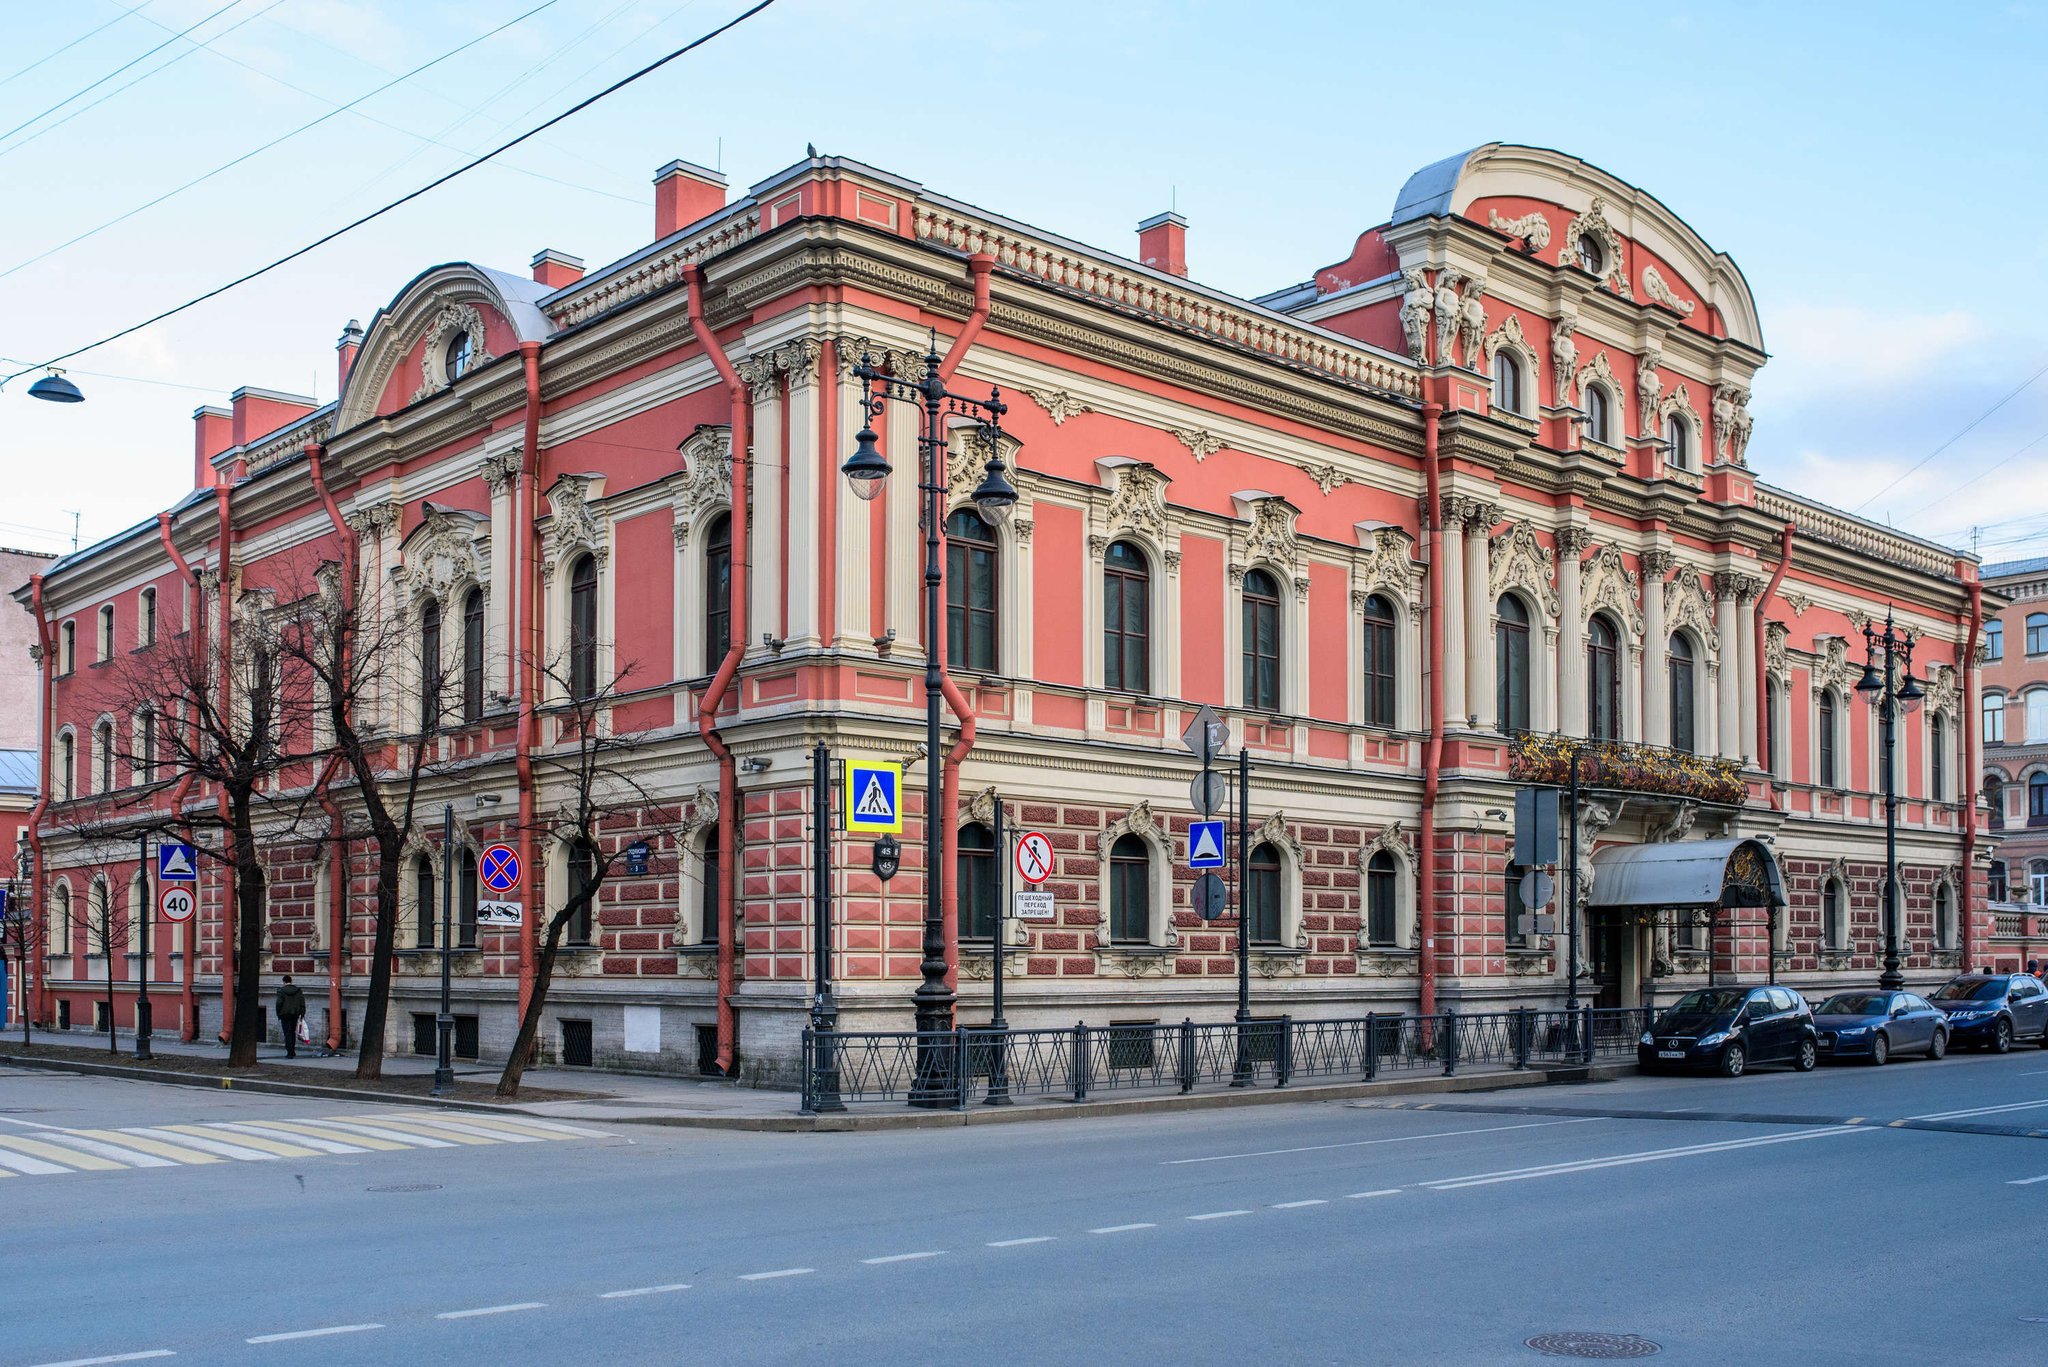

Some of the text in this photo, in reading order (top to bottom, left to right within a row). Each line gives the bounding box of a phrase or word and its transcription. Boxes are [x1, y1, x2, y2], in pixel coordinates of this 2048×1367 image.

[881, 847, 891, 855] 45
[882, 861, 892, 869] 45
[167, 897, 188, 912] 40
